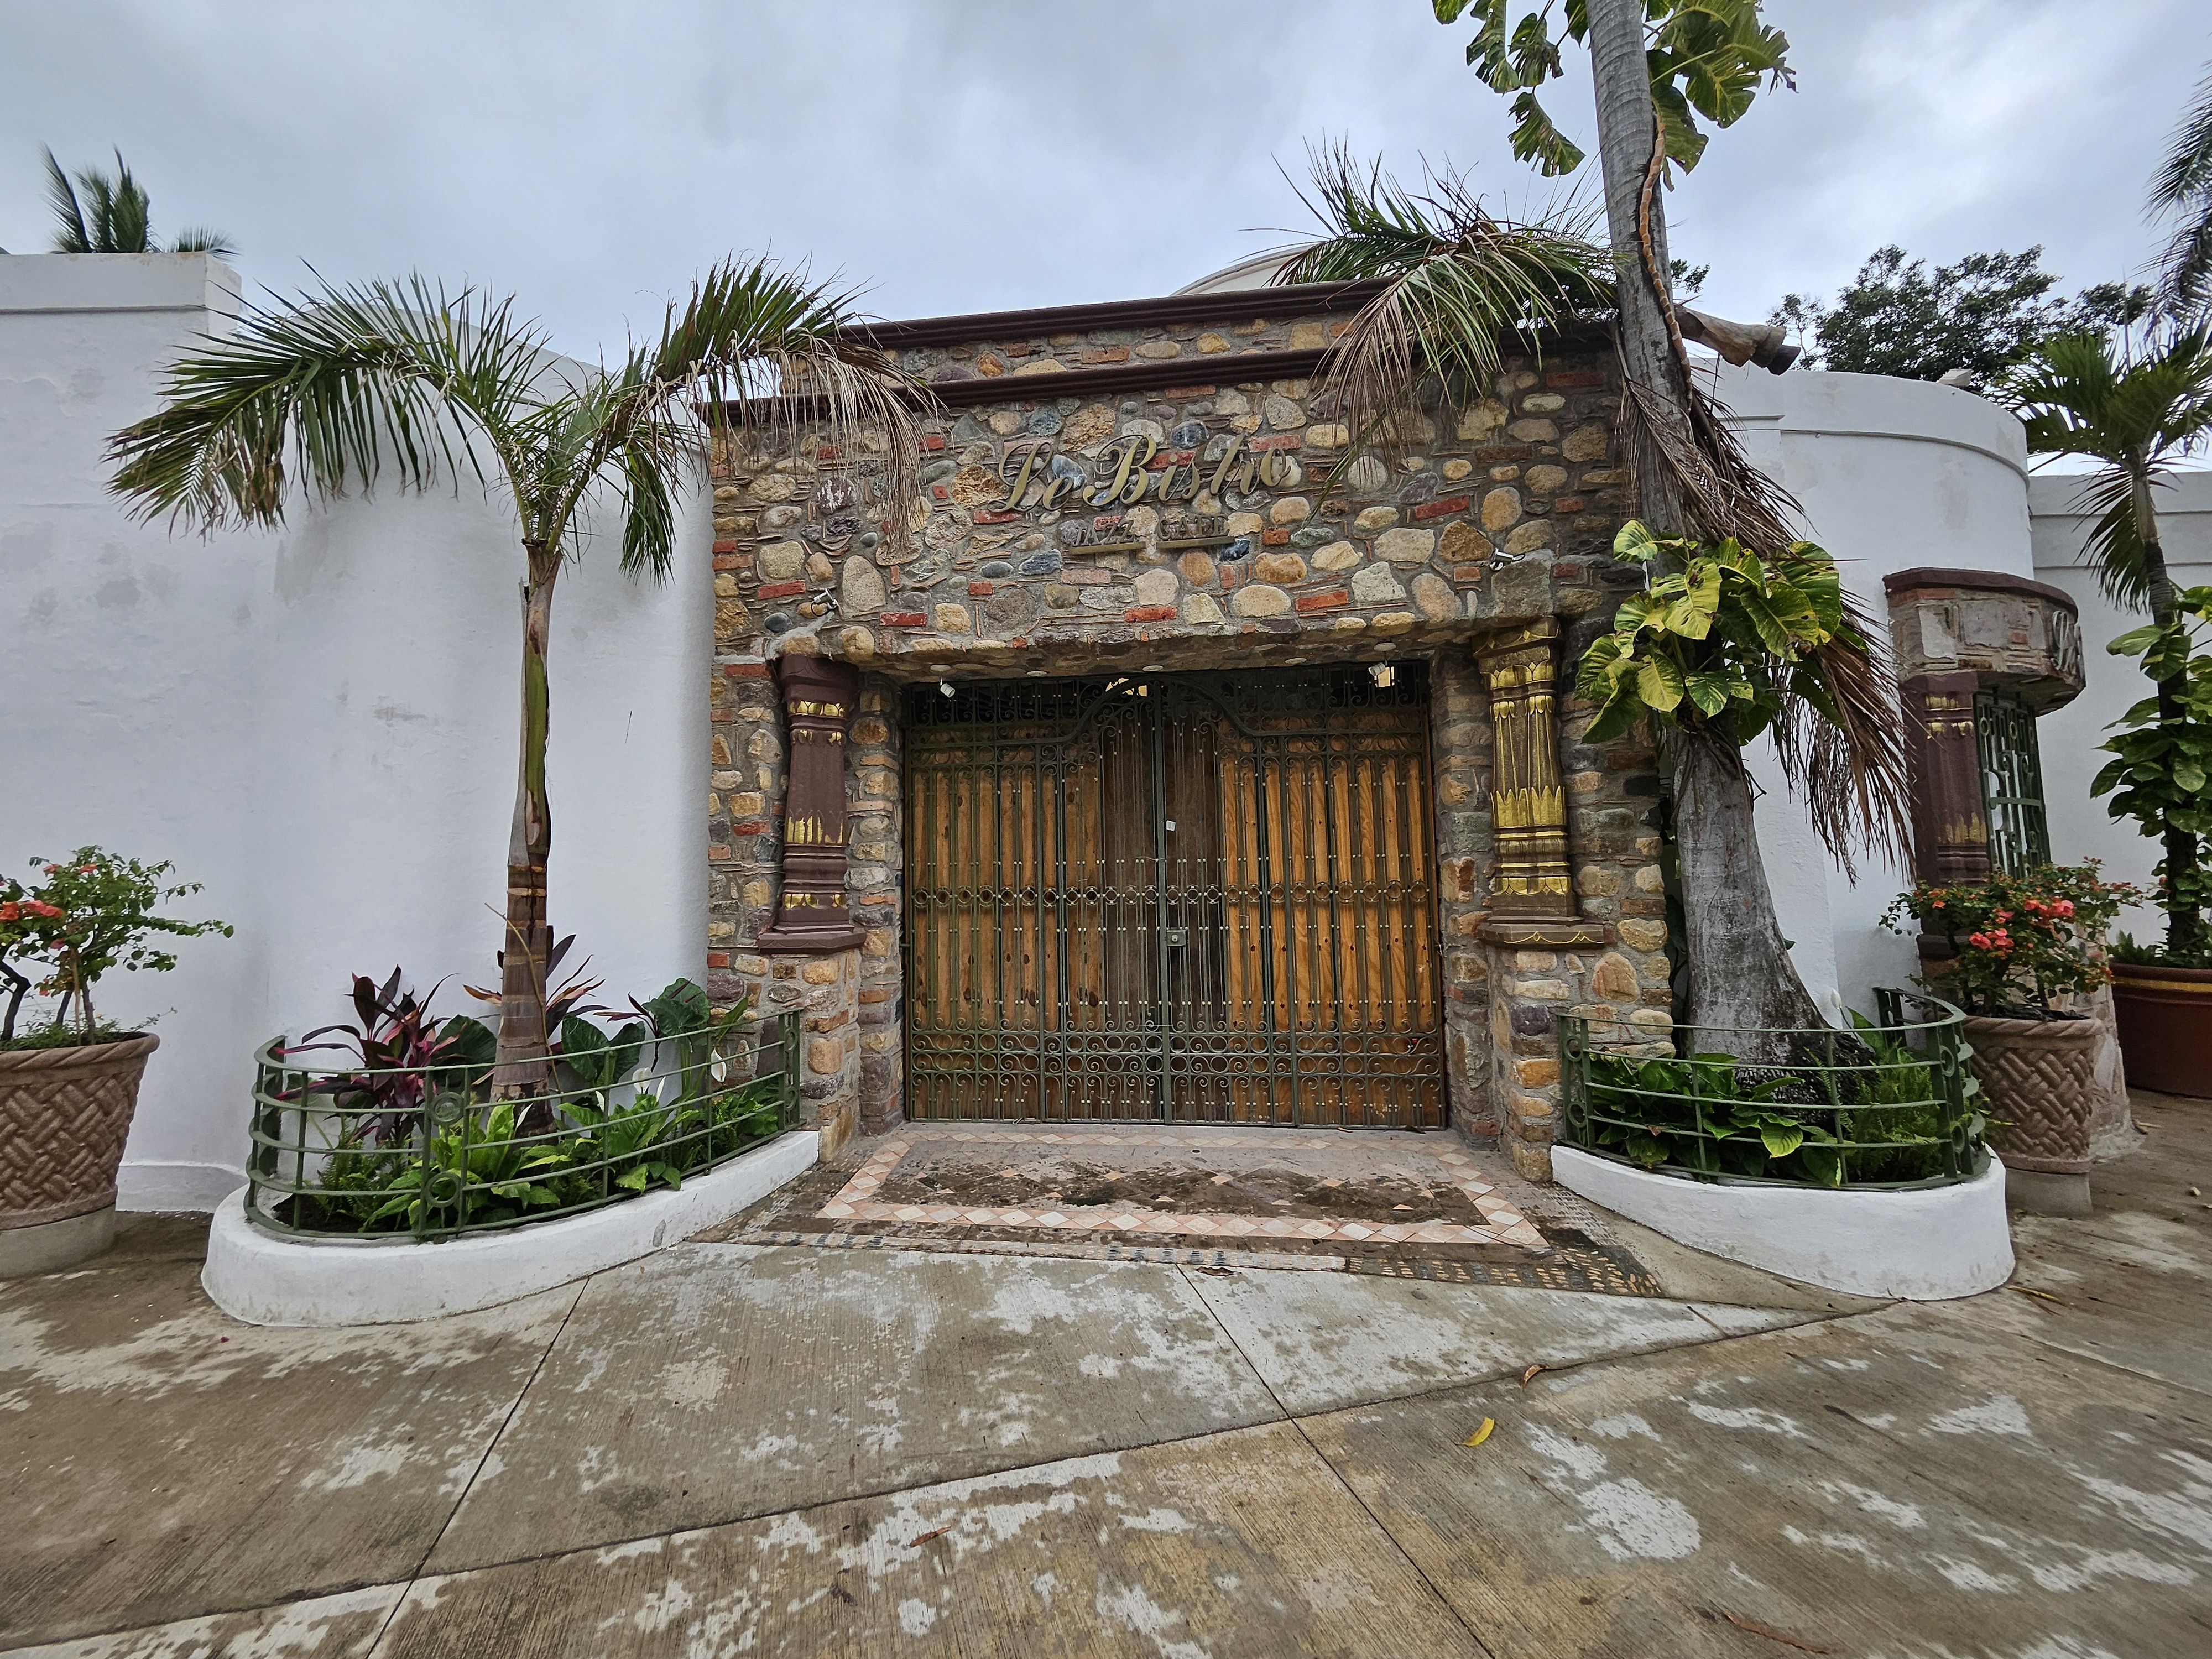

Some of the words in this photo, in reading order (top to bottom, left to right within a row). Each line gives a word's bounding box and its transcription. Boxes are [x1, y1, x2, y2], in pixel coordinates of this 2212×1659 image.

[988, 442, 1073, 512] Le
[1082, 433, 1291, 507] Bistro
[1072, 520, 1134, 546] JAZZ
[1156, 514, 1230, 541] CAFE
